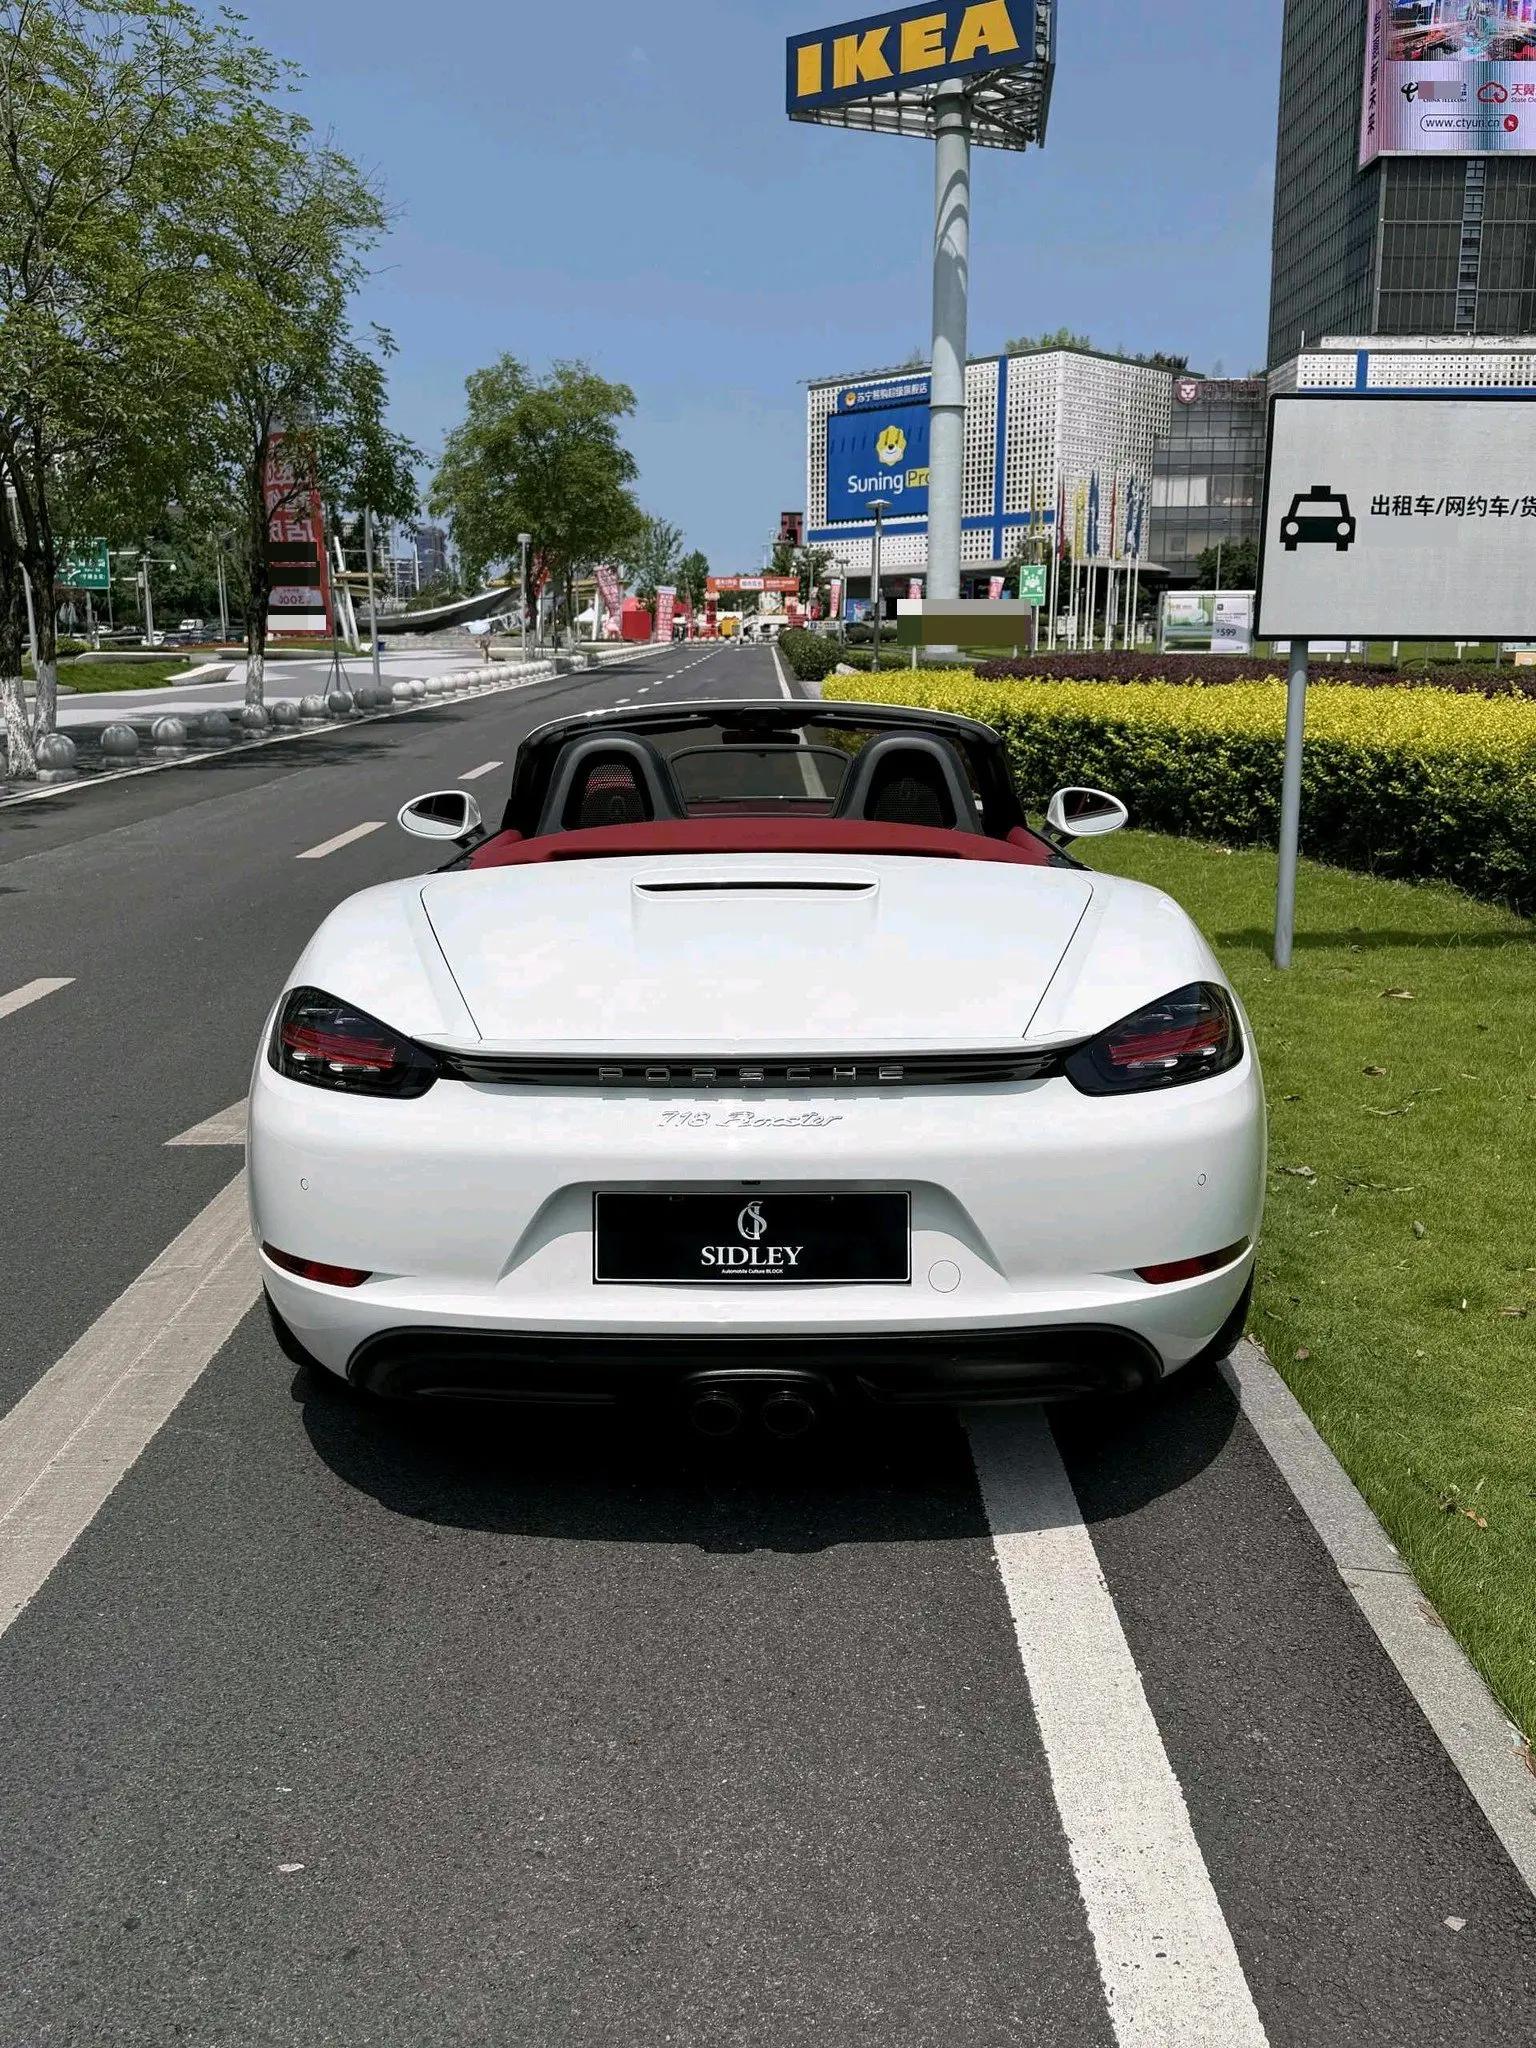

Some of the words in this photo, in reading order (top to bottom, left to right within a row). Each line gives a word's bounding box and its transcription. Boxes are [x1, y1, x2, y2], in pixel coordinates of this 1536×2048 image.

[797, 0, 1020, 97] IKEA
[1425, 118, 1500, 130] www.ctyun.cn
[847, 471, 904, 495] Suning
[1370, 494, 1536, 518] 出租车/网约车/货
[598, 1065, 904, 1082] PORSCHE
[656, 1110, 712, 1128] 718
[714, 1110, 844, 1128] Boxster
[701, 1245, 804, 1266] SIDLEY
